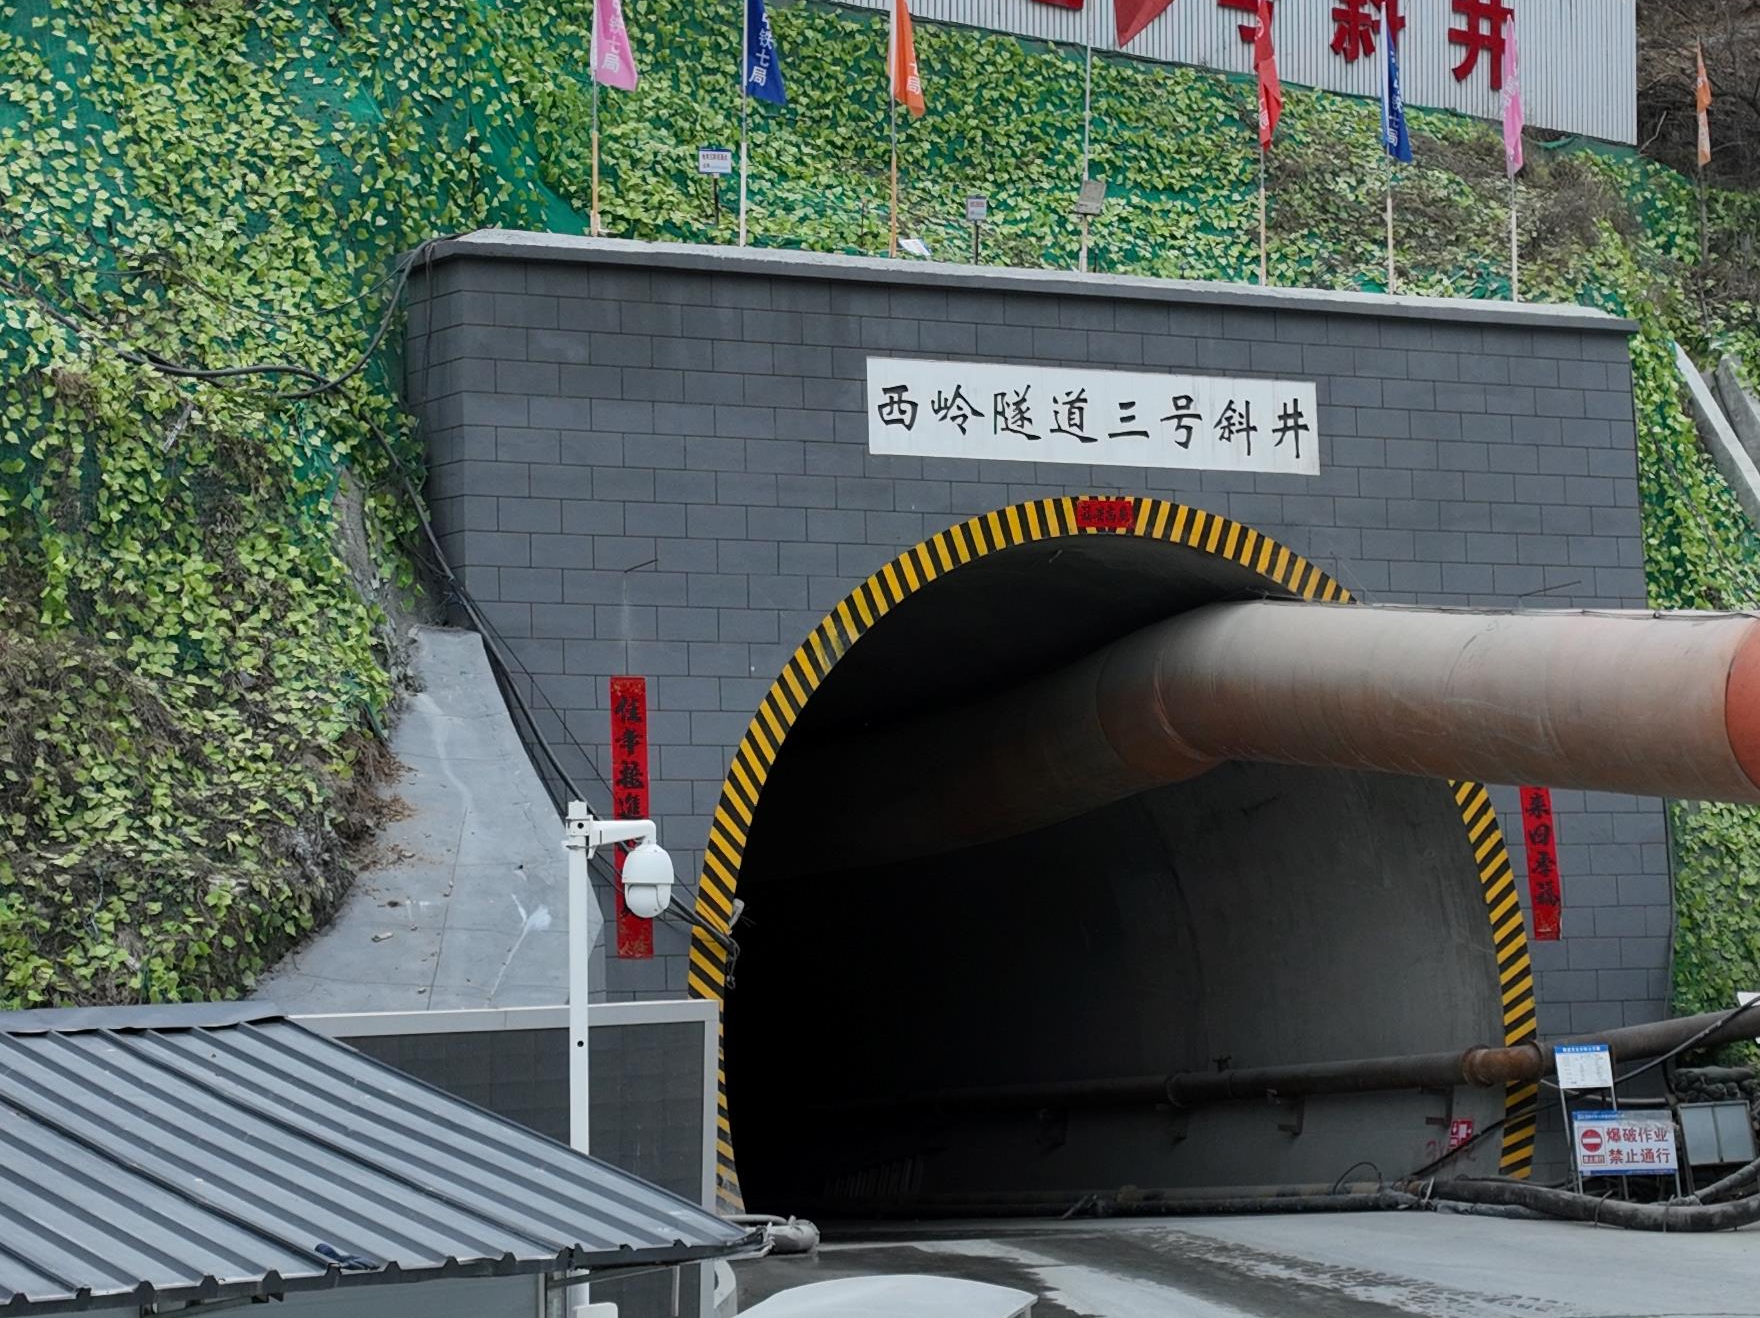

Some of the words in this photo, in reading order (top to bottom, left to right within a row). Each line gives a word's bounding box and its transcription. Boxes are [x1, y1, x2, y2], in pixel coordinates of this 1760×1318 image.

[877, 384, 1310, 459] 西岭隧道三号斜井
[1606, 1127, 1669, 1144] 爆破作业
[1609, 1148, 1671, 1165] 禁止通行
